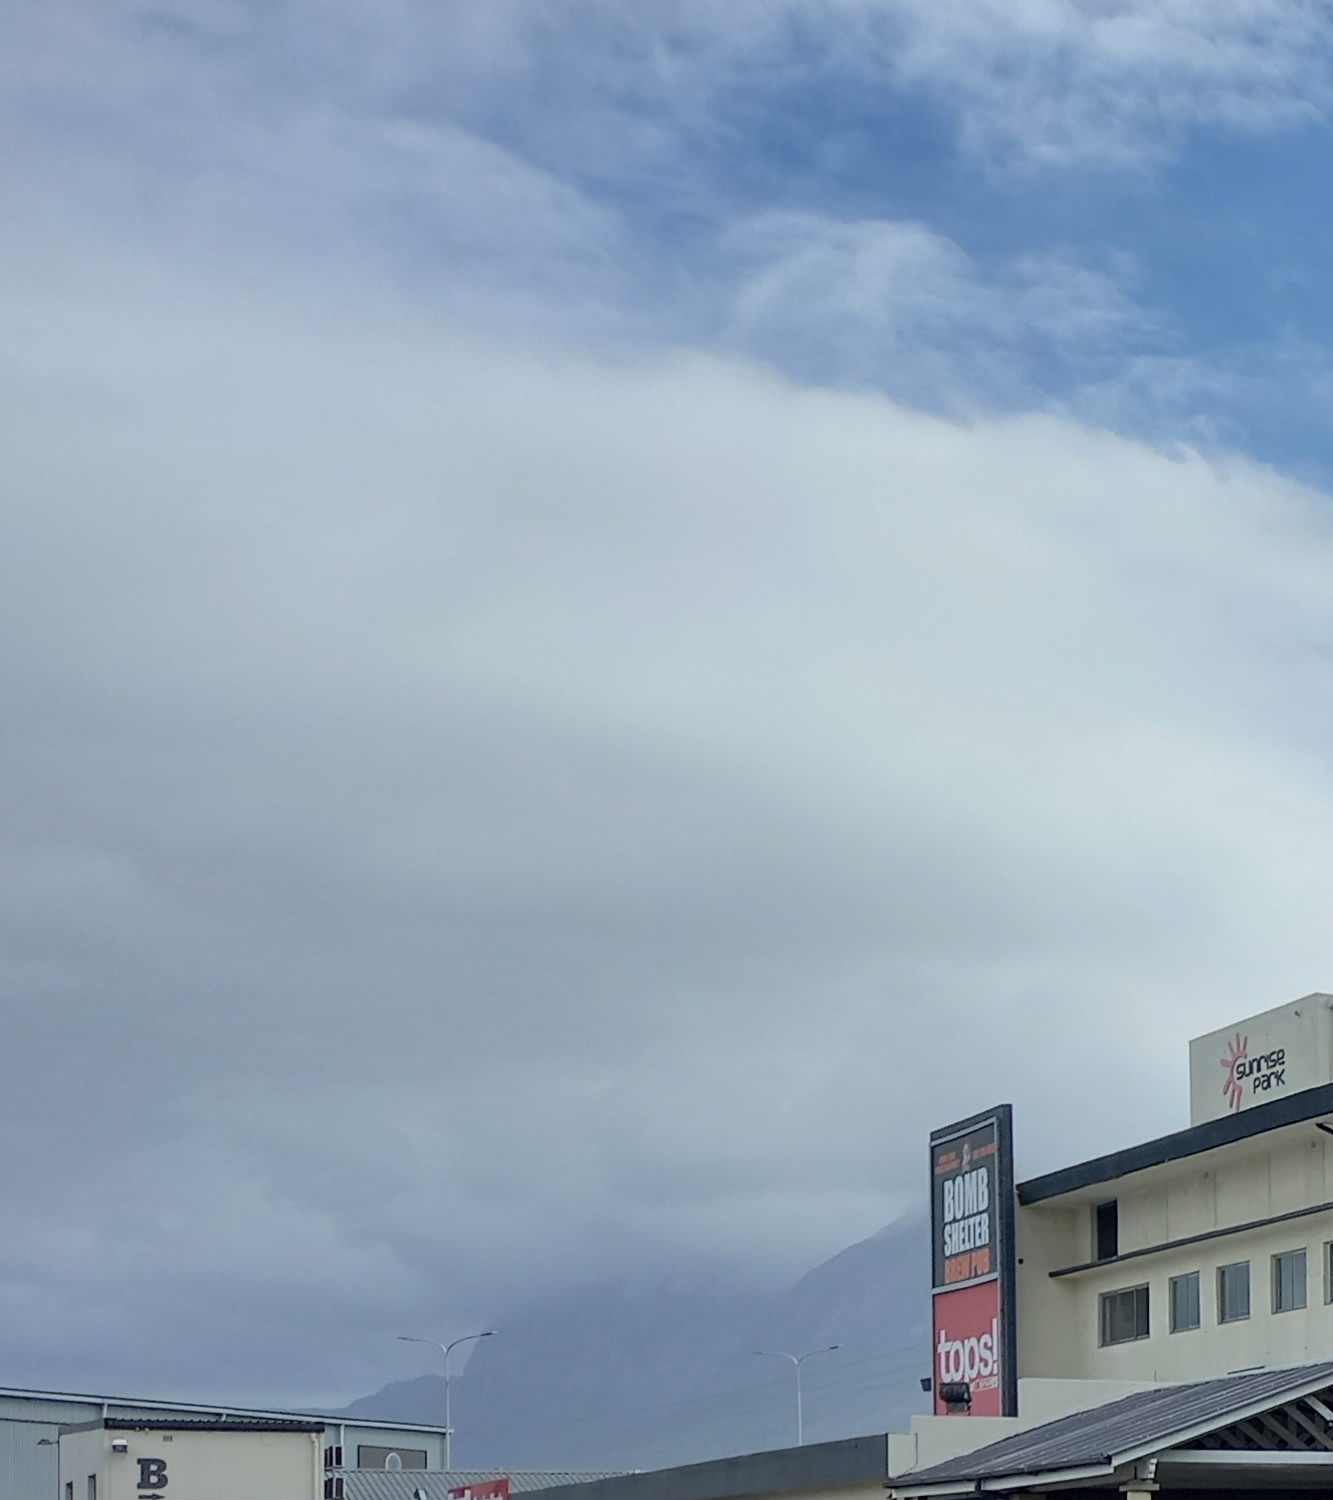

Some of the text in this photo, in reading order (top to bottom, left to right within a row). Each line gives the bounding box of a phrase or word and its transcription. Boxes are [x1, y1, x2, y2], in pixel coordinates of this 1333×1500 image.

[943, 1166, 989, 1224] BOMB
[943, 1211, 990, 1258] SHELTER
[136, 1457, 169, 1490] B
